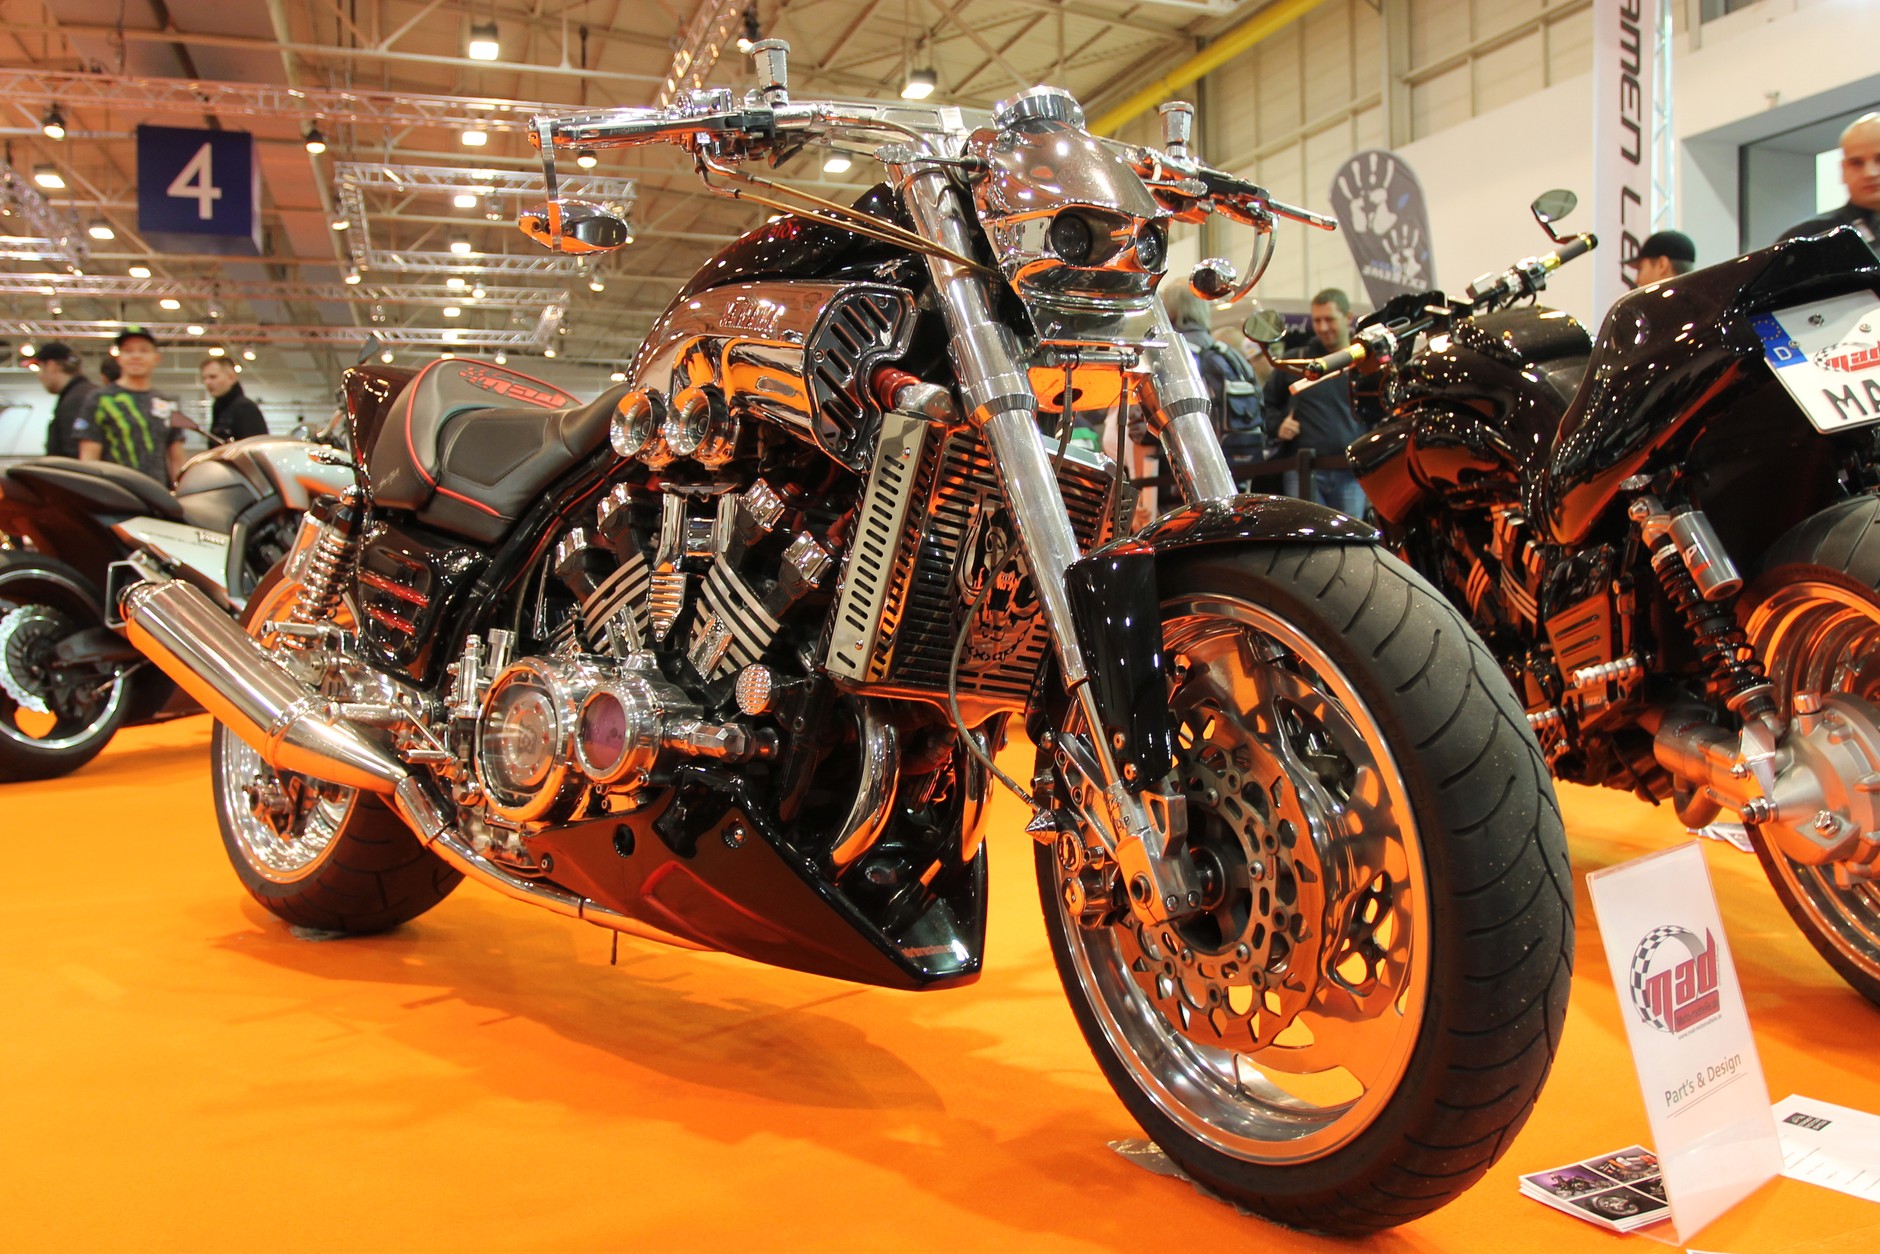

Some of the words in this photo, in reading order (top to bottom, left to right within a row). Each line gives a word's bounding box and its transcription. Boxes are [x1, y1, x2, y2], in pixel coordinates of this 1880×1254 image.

[165, 141, 223, 220] 4
[1773, 346, 1793, 361] D
[1664, 1079, 1695, 1108] Part's
[1696, 1071, 1706, 1088] &
[1706, 1053, 1742, 1082] Design
